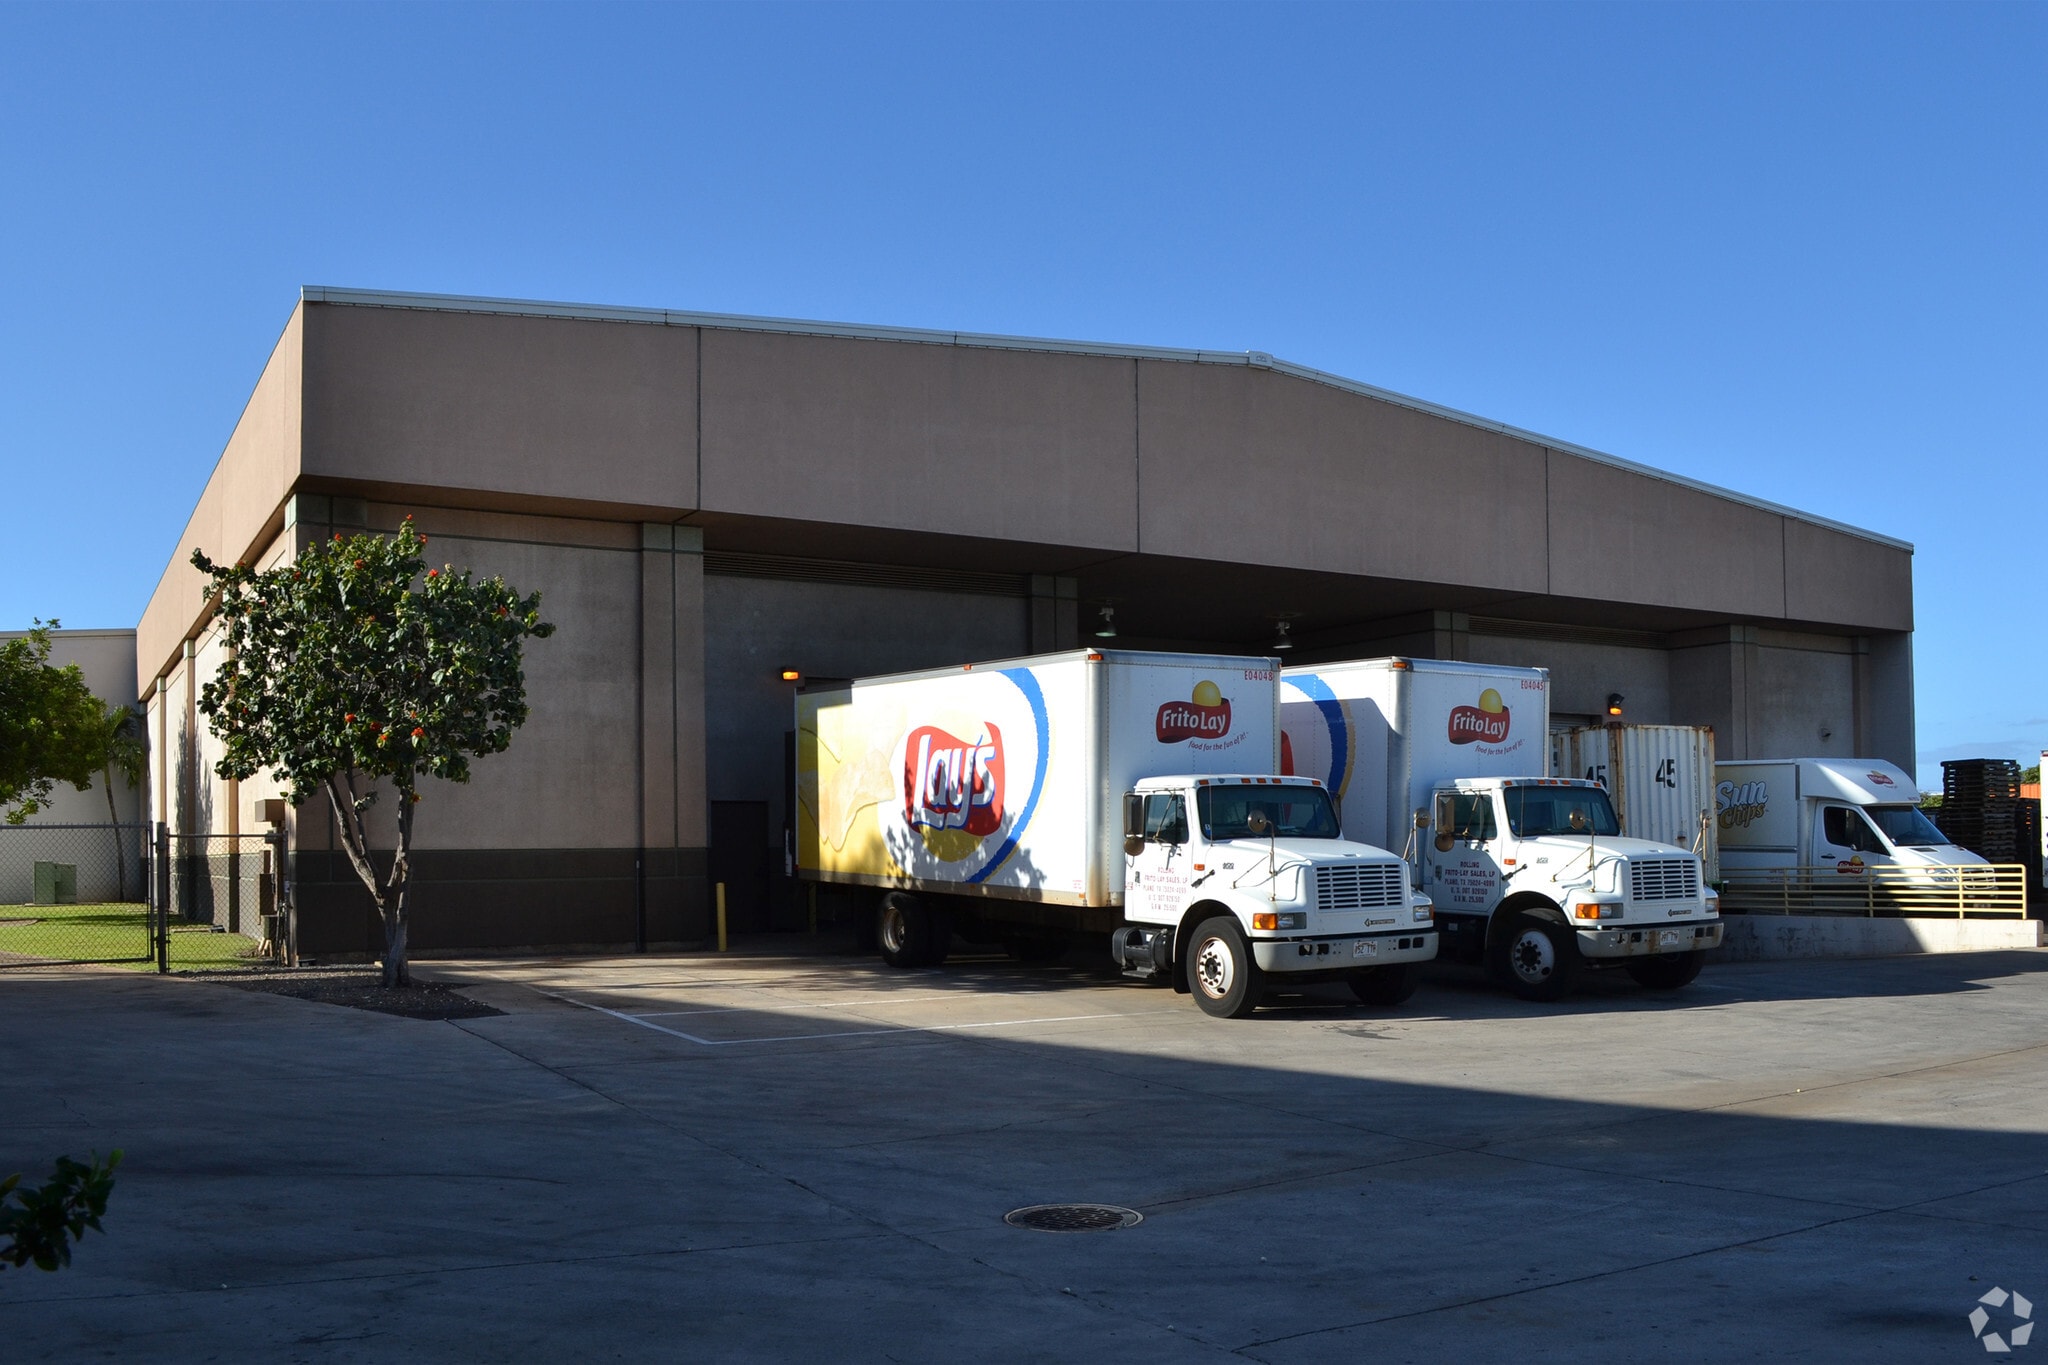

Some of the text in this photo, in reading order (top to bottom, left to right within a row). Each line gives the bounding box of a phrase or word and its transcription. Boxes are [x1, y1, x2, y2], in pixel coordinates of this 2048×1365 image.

[1244, 670, 1273, 681] E04048
[1521, 680, 1544, 690] E04045
[1213, 742, 1223, 751] the
[911, 734, 996, 831] Lay's
[1655, 758, 1676, 789] 45
[1715, 780, 1769, 815] Sun
[1719, 803, 1766, 829] Chips
[1488, 870, 1495, 878] LP
